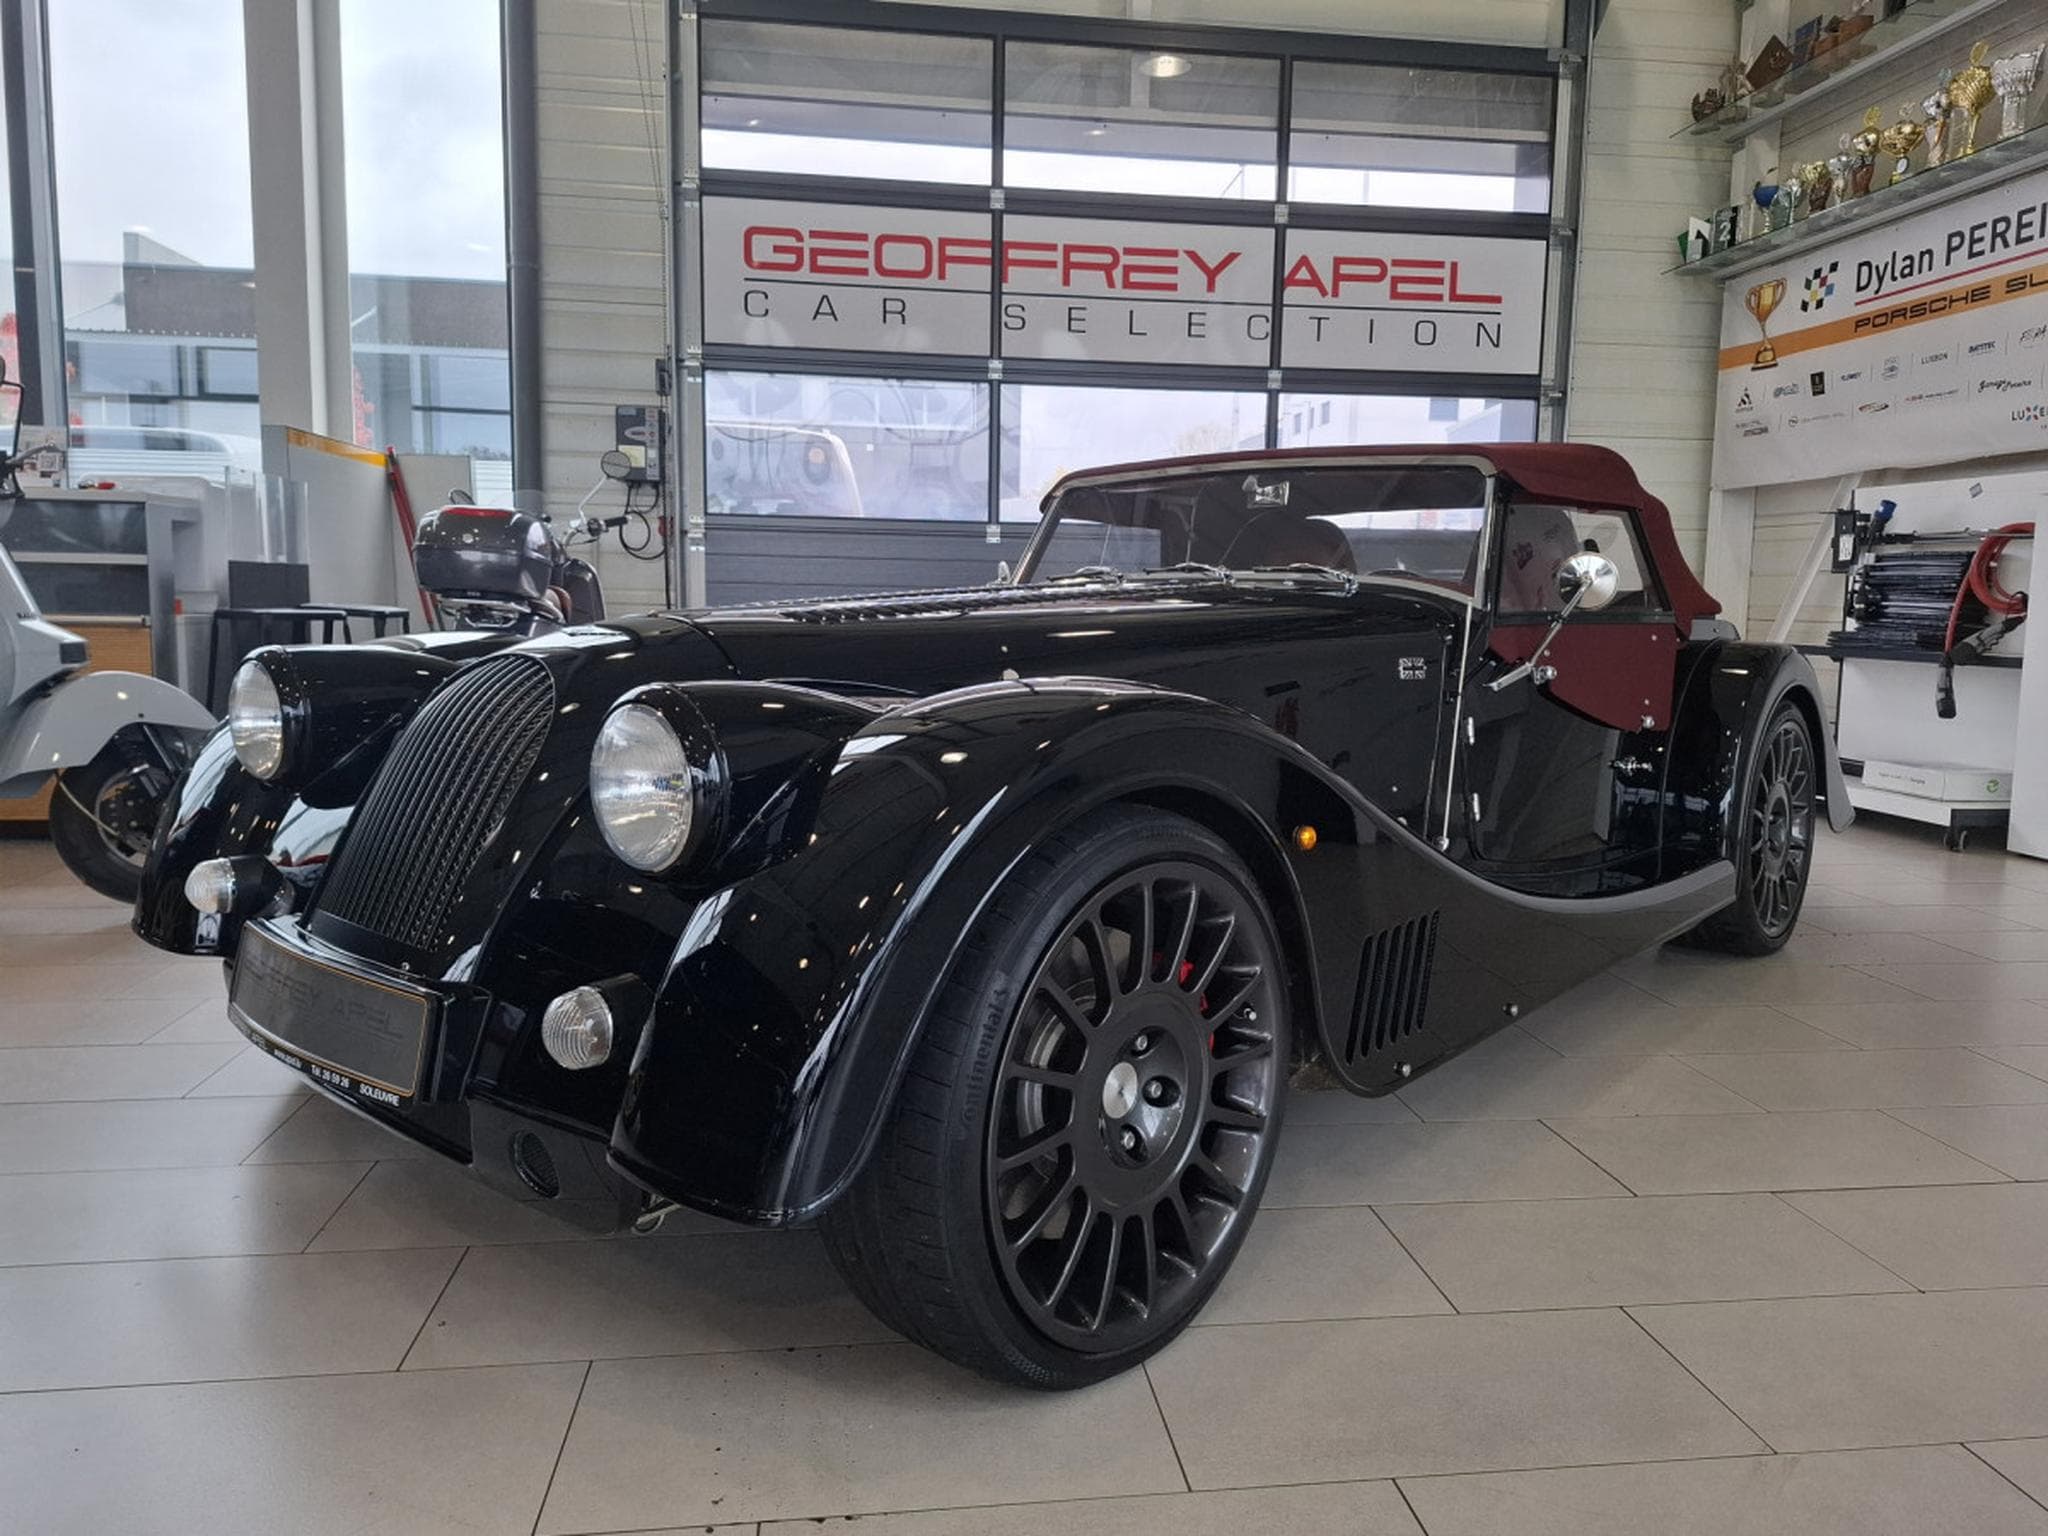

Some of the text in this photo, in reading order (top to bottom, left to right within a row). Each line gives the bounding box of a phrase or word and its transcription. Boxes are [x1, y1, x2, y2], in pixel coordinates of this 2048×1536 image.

[743, 226, 1503, 304] GEOFFREY APEL
[1856, 248, 1934, 295] Dylan
[743, 290, 1501, 348] CAR SELECTION
[1854, 284, 1991, 333] PORSCHE
[2012, 405, 2048, 420] LUXE
[359, 1083, 400, 1107] SOLEUVRE
